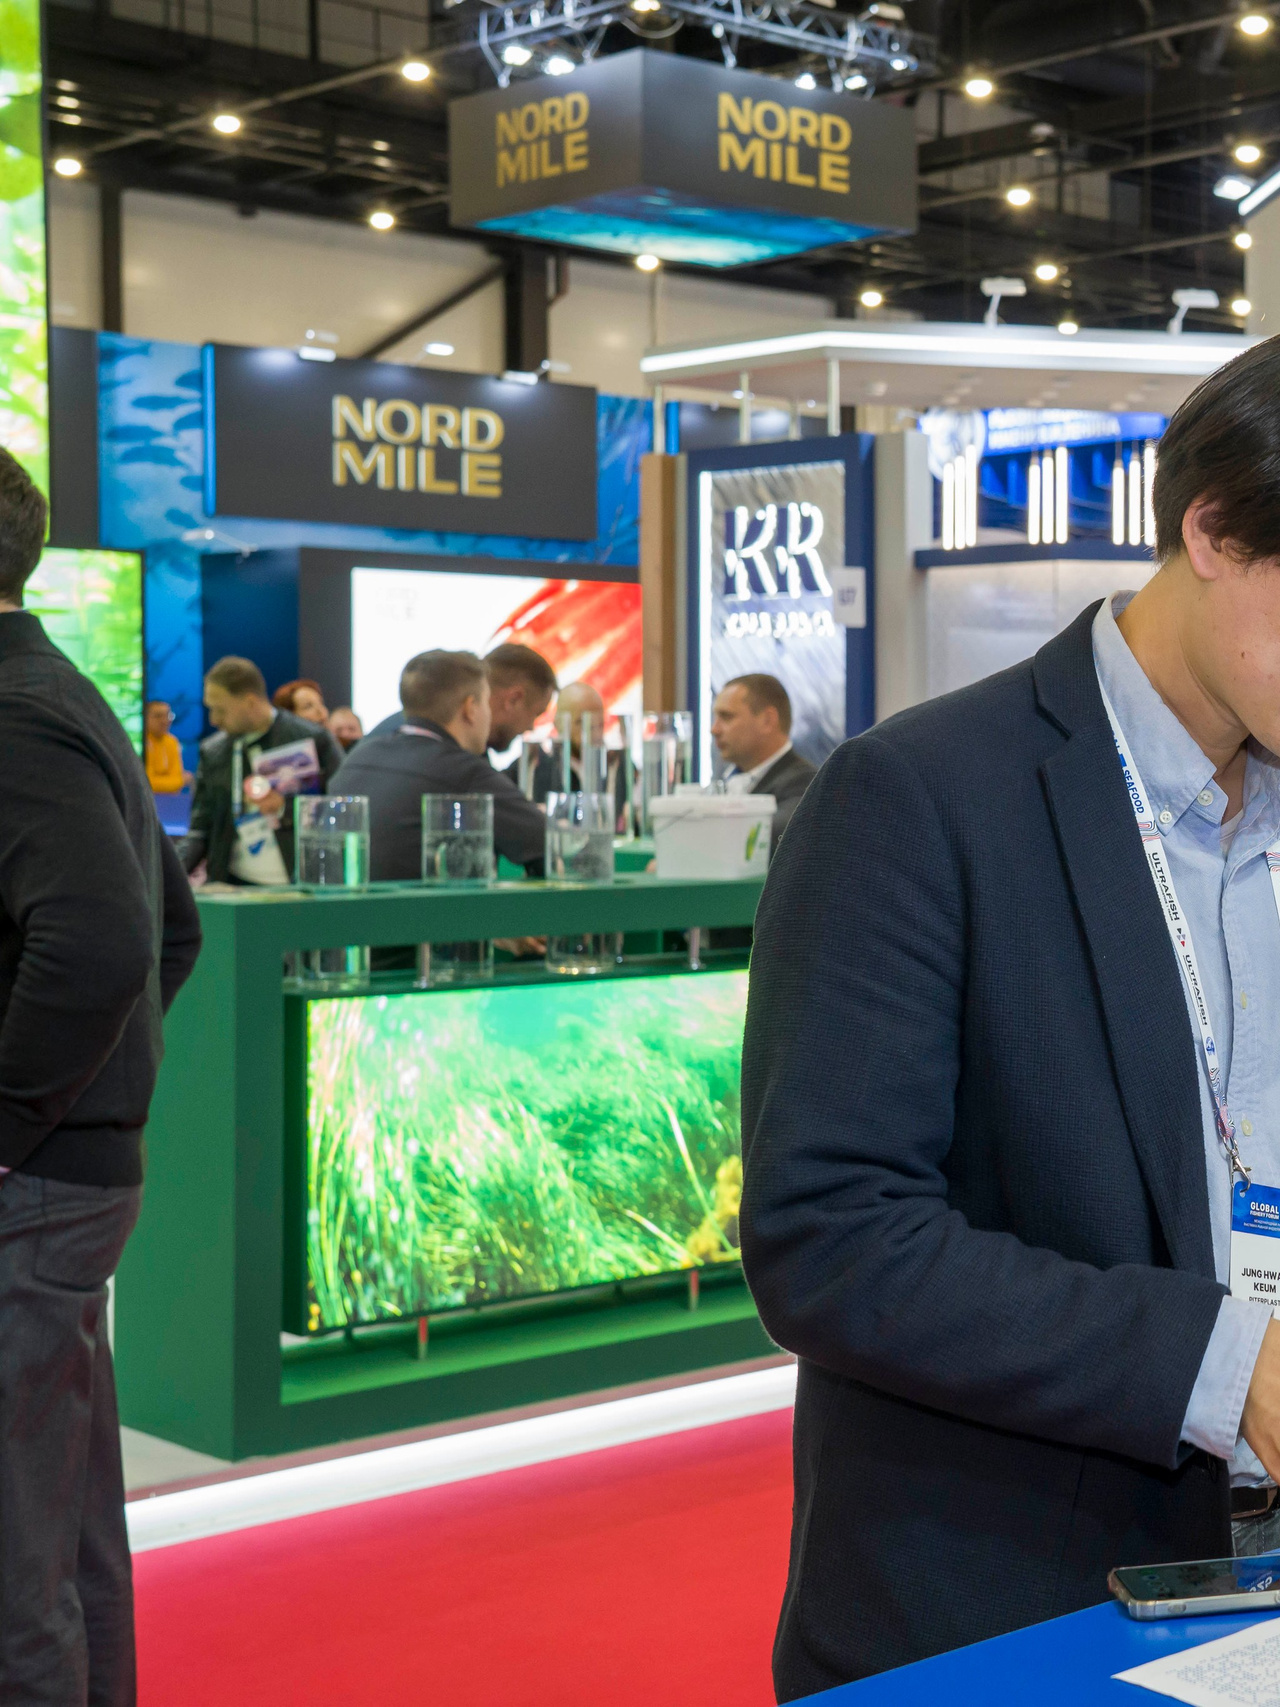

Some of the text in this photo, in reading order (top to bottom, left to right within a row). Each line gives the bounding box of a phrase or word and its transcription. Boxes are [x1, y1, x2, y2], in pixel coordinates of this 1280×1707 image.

[495, 91, 590, 146] NORD
[717, 91, 853, 153] NORD
[495, 129, 589, 189] MILE
[718, 131, 851, 194] MILE
[332, 394, 505, 452] NORD
[332, 440, 502, 499] MILE
[724, 502, 833, 601] KR
[1124, 769, 1145, 814] SEAFOOD
[1151, 852, 1181, 921] ULTRAFISH
[1185, 954, 1209, 1026] ULTRAFISH
[1250, 1201, 1279, 1214] GLOBAL
[1241, 1268, 1262, 1279] JUNG
[1253, 1282, 1277, 1293] KEUM
